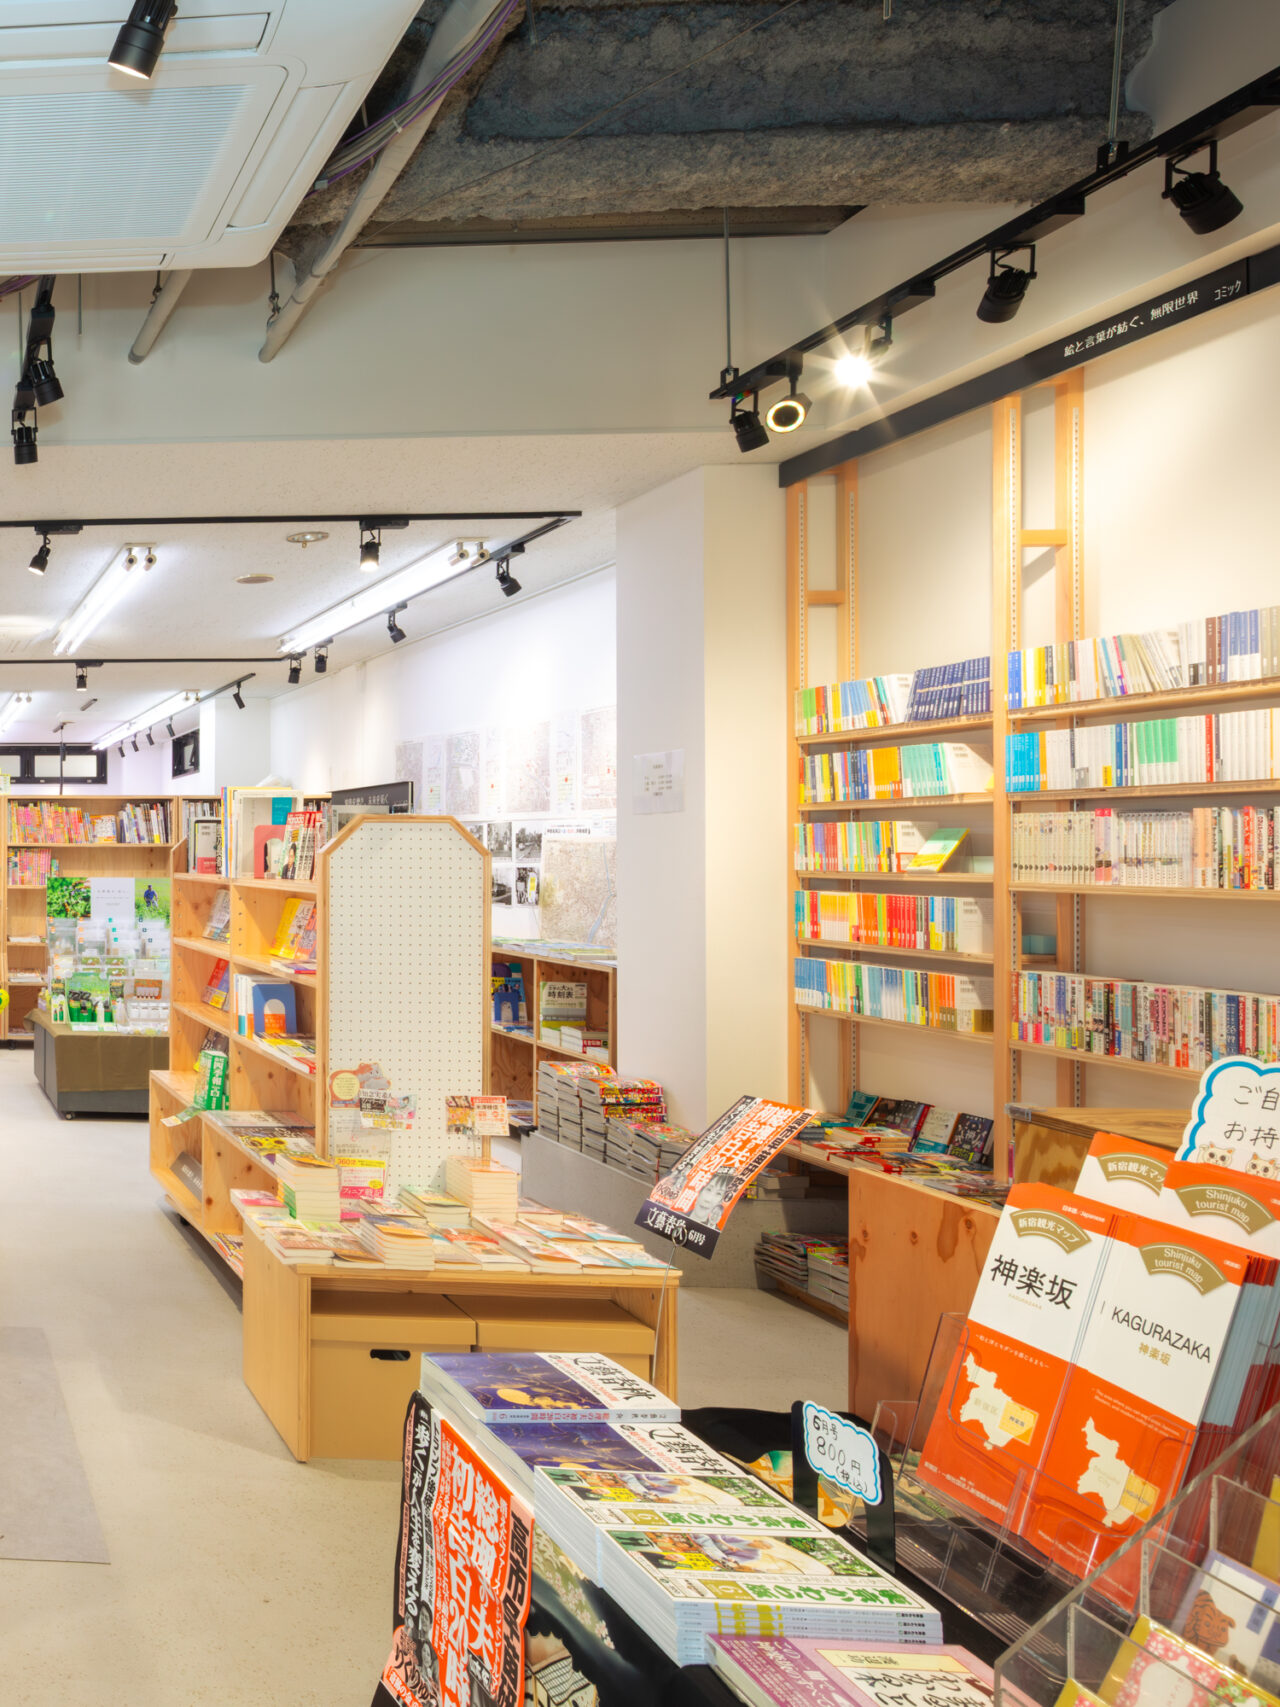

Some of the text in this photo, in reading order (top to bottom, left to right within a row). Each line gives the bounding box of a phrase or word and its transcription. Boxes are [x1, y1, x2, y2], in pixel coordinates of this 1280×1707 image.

[1214, 280, 1242, 301] コミック
[547, 991, 575, 1000] 時刻表
[1223, 1120, 1280, 1150] お持
[1195, 1199, 1250, 1224] tourist map
[1205, 1189, 1248, 1209] Shinjuku
[687, 1228, 706, 1246] 6月号
[1018, 1216, 1080, 1243] 新宿観光マップ
[1154, 1258, 1204, 1284] tourist map
[1163, 1248, 1202, 1269] Shinjuku
[989, 1254, 1078, 1310] 神楽坂
[1111, 1306, 1212, 1364] KAGURAZAKA
[1138, 1341, 1171, 1366] 神楽坂
[812, 1414, 838, 1441] 6月号
[816, 1435, 861, 1476] 800円
[744, 1582, 912, 1607] 東京かわら版
